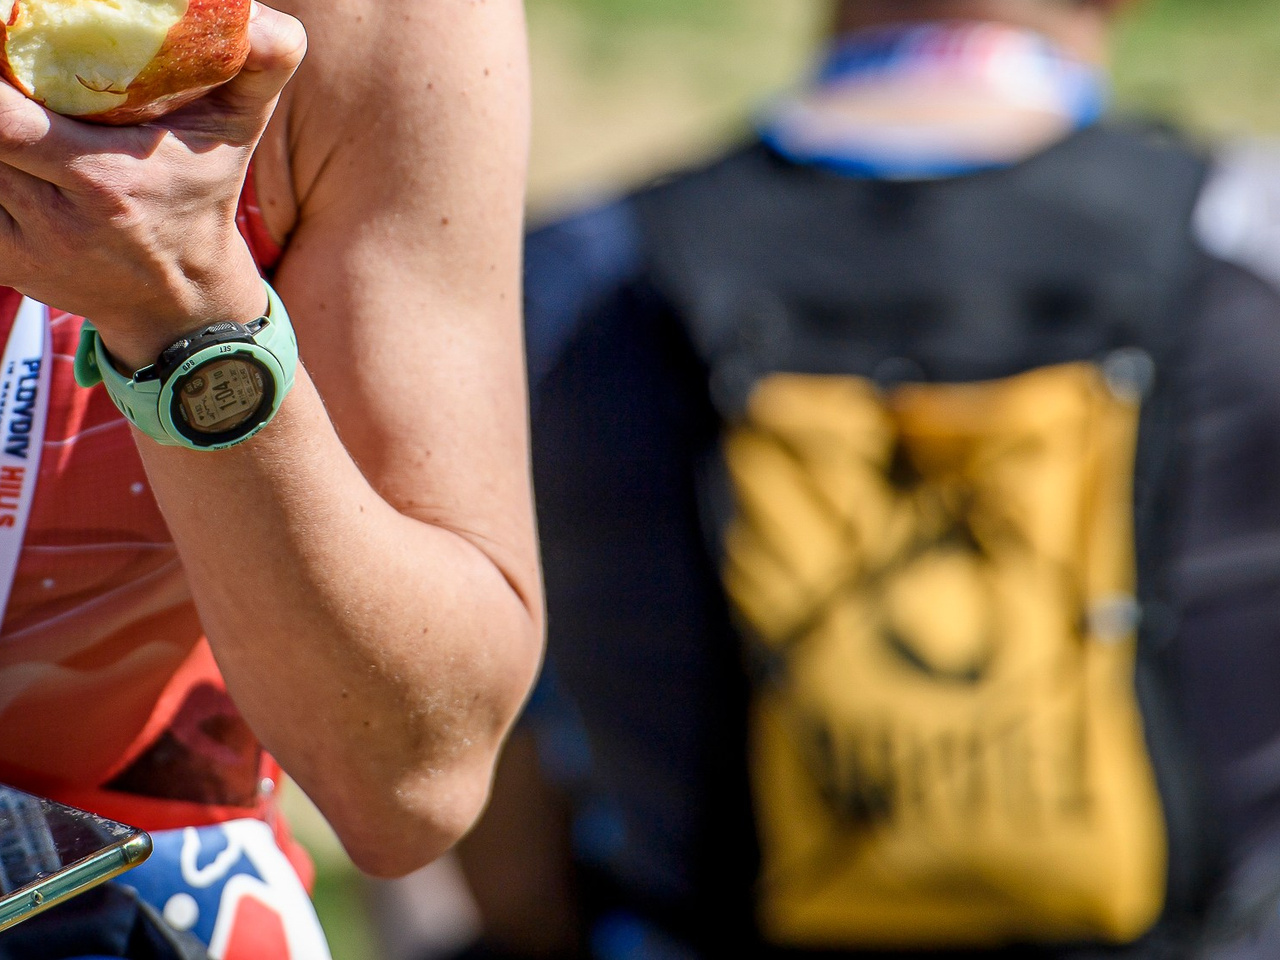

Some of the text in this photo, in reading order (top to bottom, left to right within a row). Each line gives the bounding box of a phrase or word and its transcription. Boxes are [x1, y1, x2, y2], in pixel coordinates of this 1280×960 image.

[219, 345, 232, 353] SET
[182, 359, 195, 372] GPS
[3, 358, 42, 460] PLOVDIV
